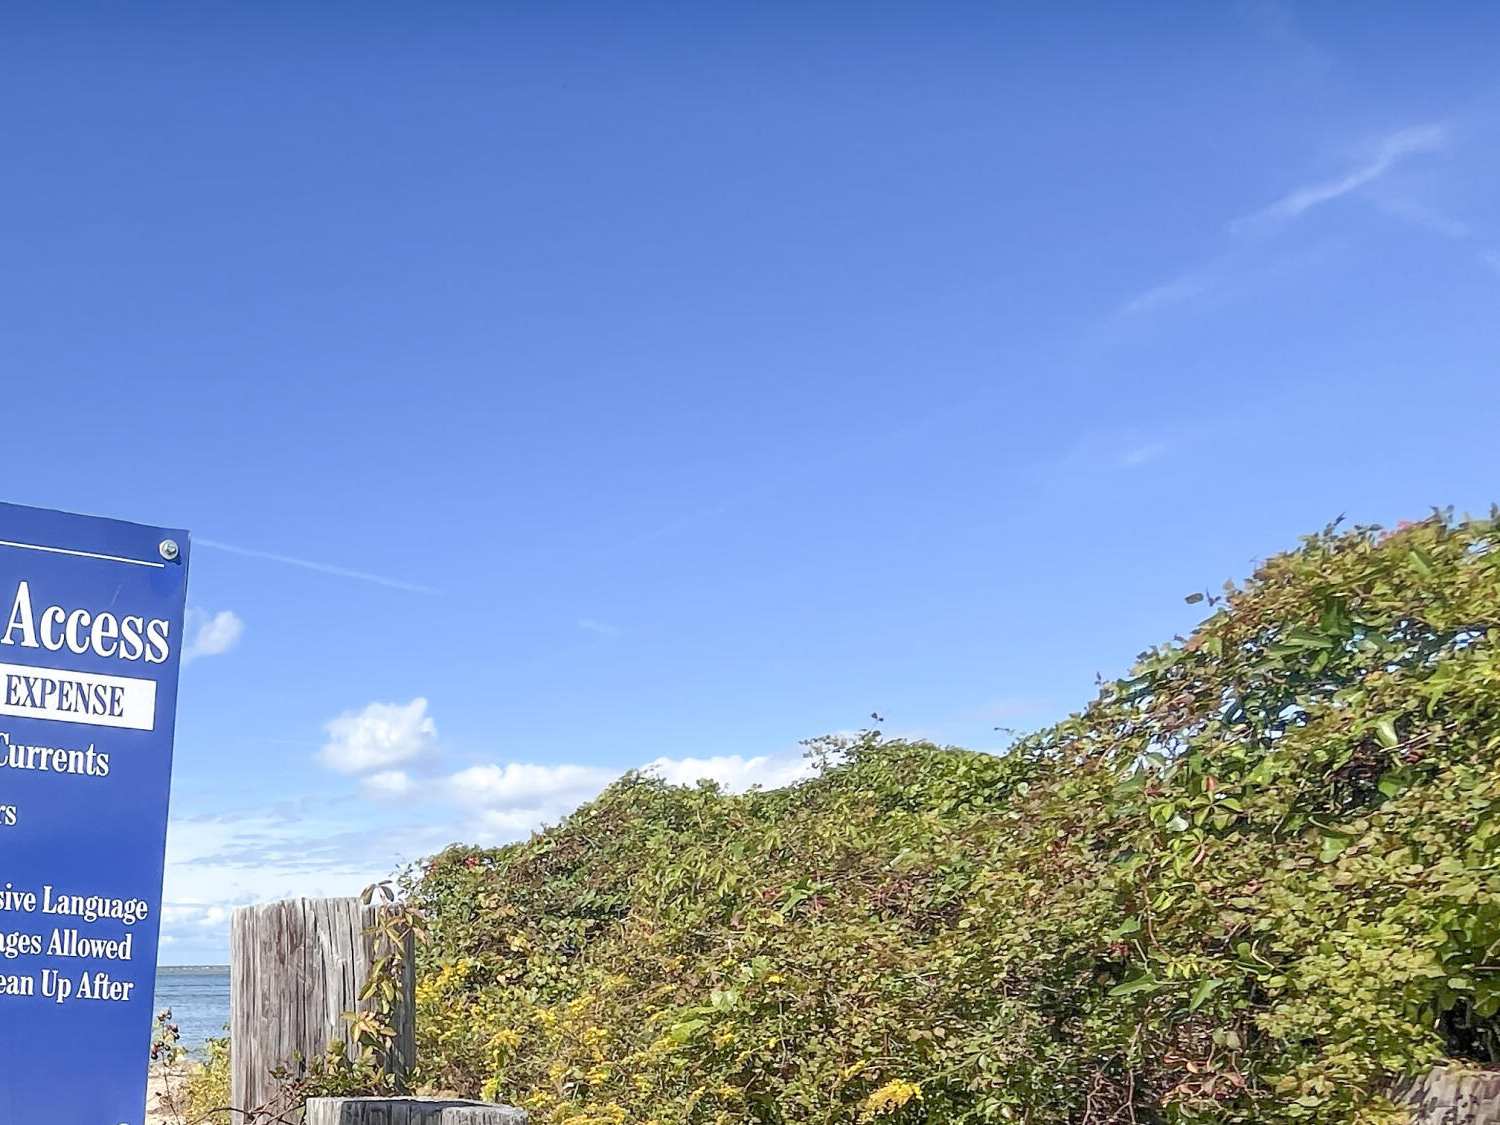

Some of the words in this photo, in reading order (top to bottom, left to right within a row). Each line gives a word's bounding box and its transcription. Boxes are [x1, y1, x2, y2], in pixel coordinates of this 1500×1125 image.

[0, 581, 169, 664] Access
[4, 674, 125, 717] EXPENSE
[42, 885, 148, 925] Language
[46, 928, 132, 960] Allowed
[41, 969, 72, 1004] Up
[75, 971, 134, 1001] After
